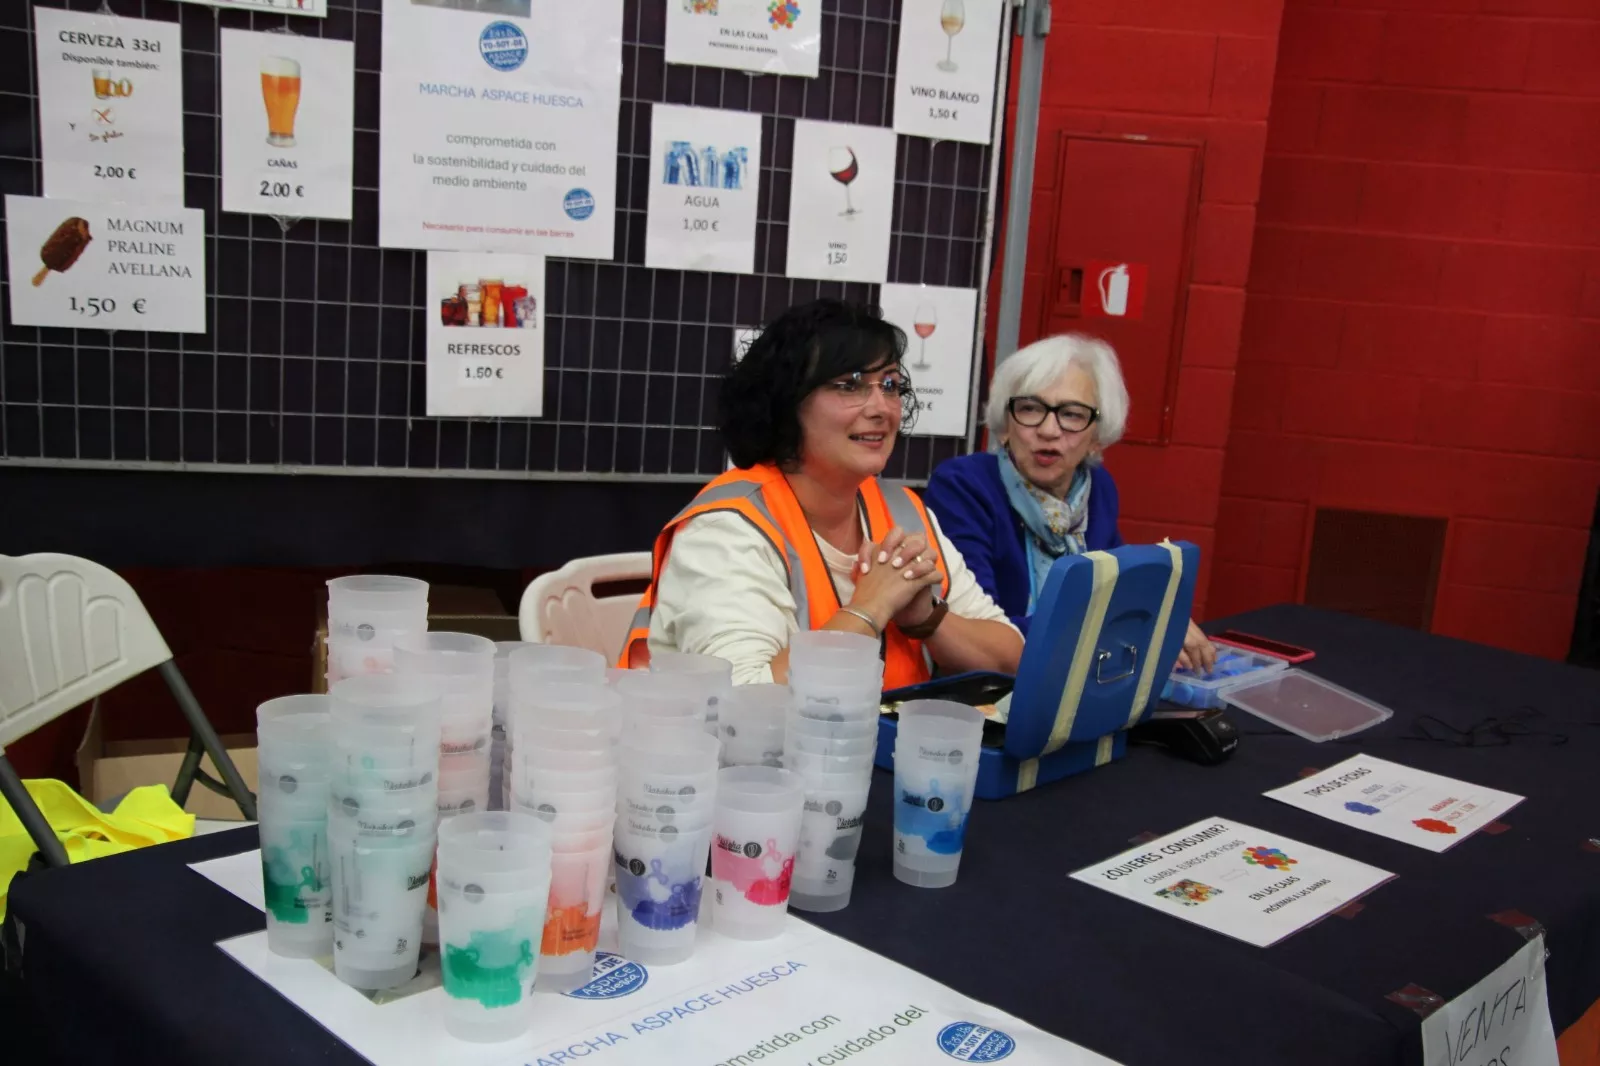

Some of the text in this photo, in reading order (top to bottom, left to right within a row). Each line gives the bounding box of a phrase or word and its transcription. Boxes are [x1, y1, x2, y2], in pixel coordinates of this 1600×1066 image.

[58, 30, 161, 52] CERVEZA 33cl
[62, 52, 160, 71] Disponible también:
[419, 82, 584, 108] MARCHA ASPACE HUESCA
[910, 85, 980, 104] VINO BLANCO
[952, 110, 958, 120] €
[446, 133, 556, 151] comprometida con
[94, 165, 136, 179] 2,00 €
[413, 153, 586, 176] la sostenibilidad y cuidado del
[295, 185, 304, 197] €
[432, 175, 527, 191] medio ambiente
[684, 195, 720, 209] AGUA
[107, 217, 184, 236] MAGNUM
[682, 218, 719, 232] 1,00 €
[107, 239, 176, 257] PRALINE
[107, 262, 192, 279] AVELLANA
[68, 296, 147, 317] 1,50 €
[447, 343, 521, 356] REFRESCOS
[495, 368, 503, 379] €
[1304, 784, 1335, 797] TIPOS
[1101, 823, 1229, 880] ¿QUIERES CONSUMIR?
[1143, 868, 1178, 884] CAMBIA
[1201, 850, 1218, 862] POR
[1248, 875, 1301, 901] EN LAS CAJAS
[631, 993, 722, 1035] ASPACE
[715, 959, 808, 999] HUESCA
[800, 1014, 841, 1035] con
[1445, 976, 1527, 1066] VENTA
[817, 1004, 929, 1066] cuidado del
